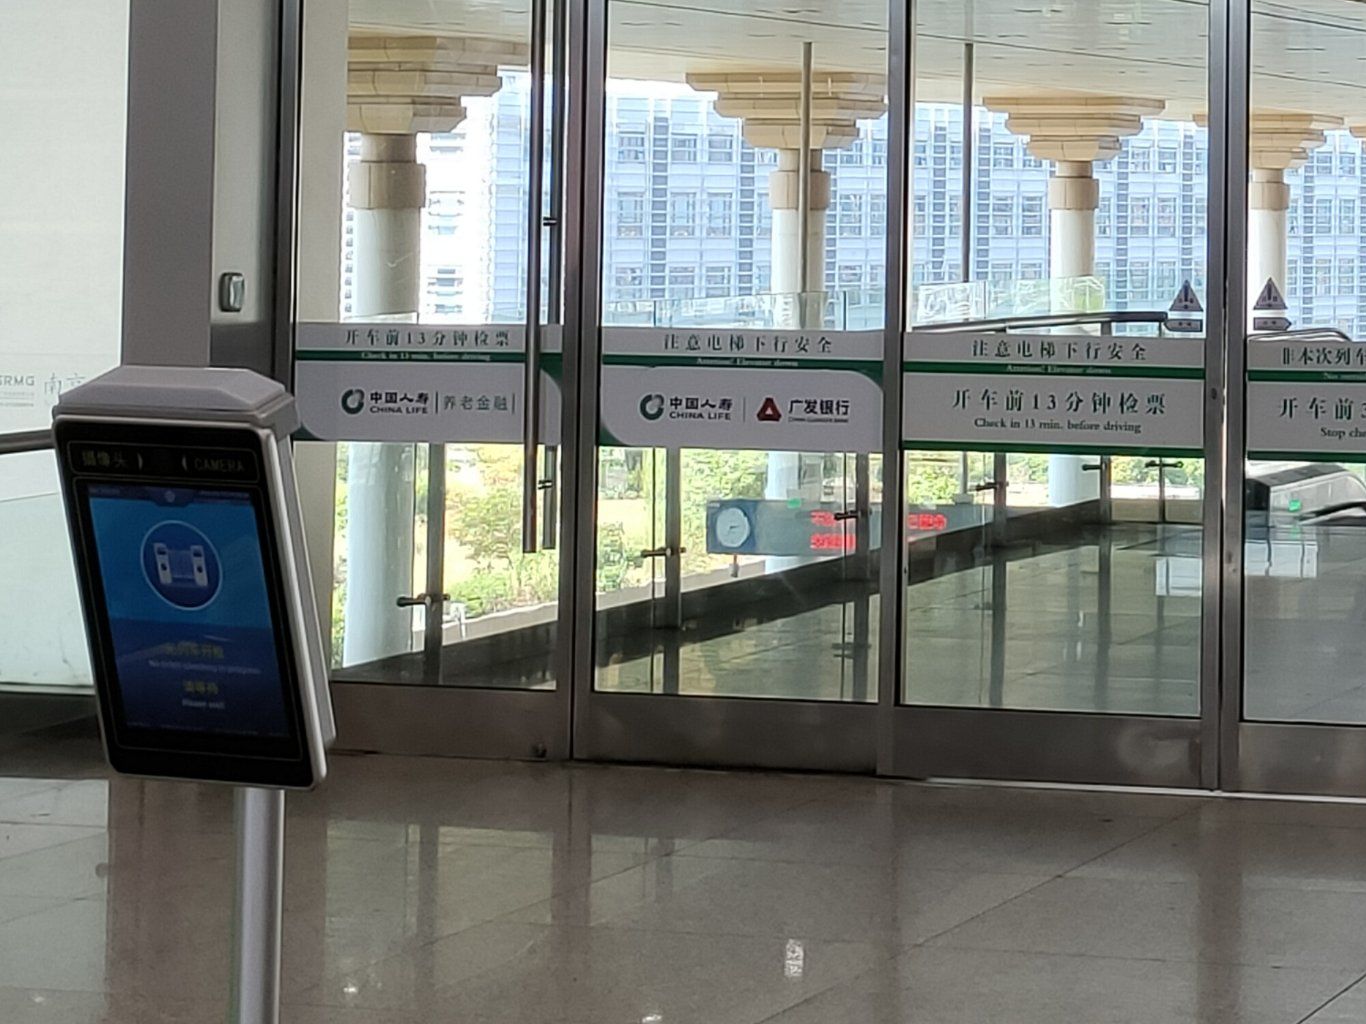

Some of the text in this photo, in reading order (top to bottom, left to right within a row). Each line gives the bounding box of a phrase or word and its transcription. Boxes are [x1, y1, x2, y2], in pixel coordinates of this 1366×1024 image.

[345, 328, 510, 347] 开车前13分钟检票
[664, 333, 834, 354] 注意电梯下行安全
[972, 338, 1148, 362] 注意电梯下行安全
[369, 391, 430, 405] 中国人寿
[669, 396, 850, 416] 中国人寿 广发银行
[952, 388, 1166, 415] 开车前13分钟检票
[369, 405, 429, 415] CHINA LIFE
[669, 411, 705, 420] CHINA
[707, 411, 732, 421] LIFE
[974, 417, 1008, 428] Check
[1011, 418, 1021, 428] in
[1067, 419, 1100, 430] before
[1103, 420, 1142, 434] driving
[1320, 426, 1346, 439] Stop
